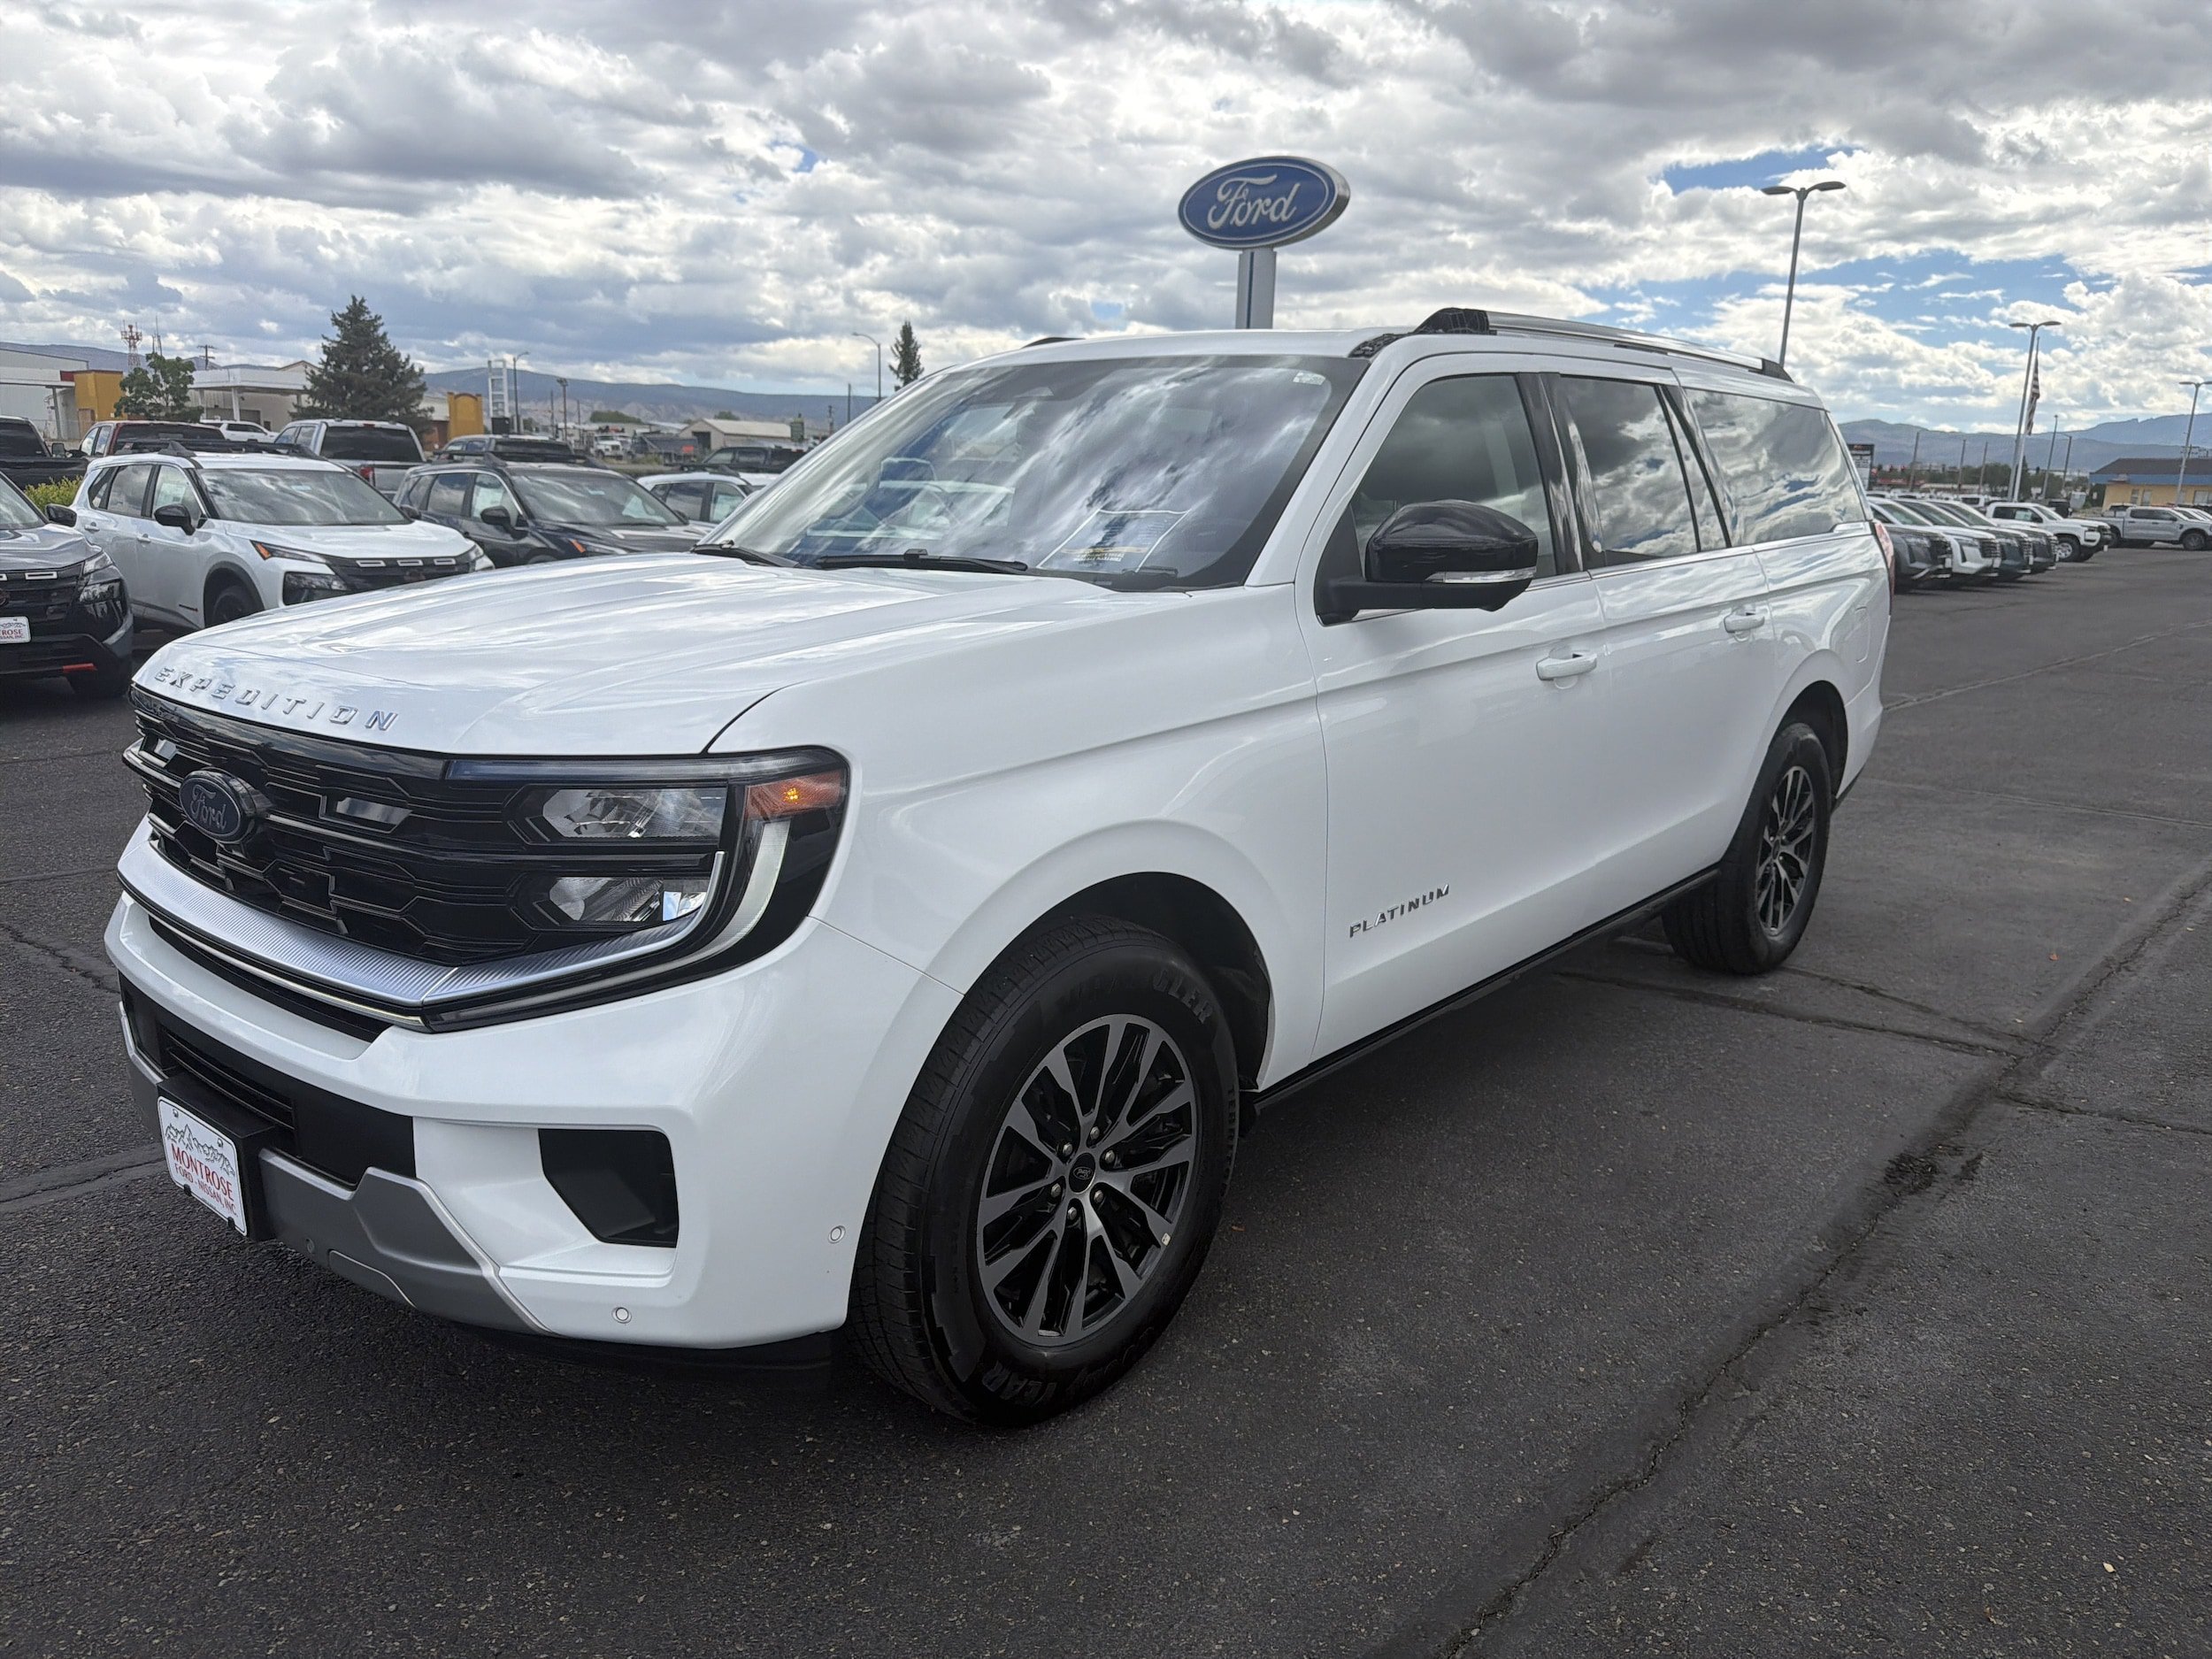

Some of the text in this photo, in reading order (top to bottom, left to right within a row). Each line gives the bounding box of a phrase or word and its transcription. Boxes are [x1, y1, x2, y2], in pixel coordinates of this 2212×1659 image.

[1207, 173, 1301, 230] Ford
[154, 667, 398, 732] EXPEDITION
[189, 784, 228, 830] Ford
[1349, 884, 1449, 938] PLATINUM
[171, 1143, 234, 1202] MONTROSE
[174, 1163, 194, 1183] FORD
